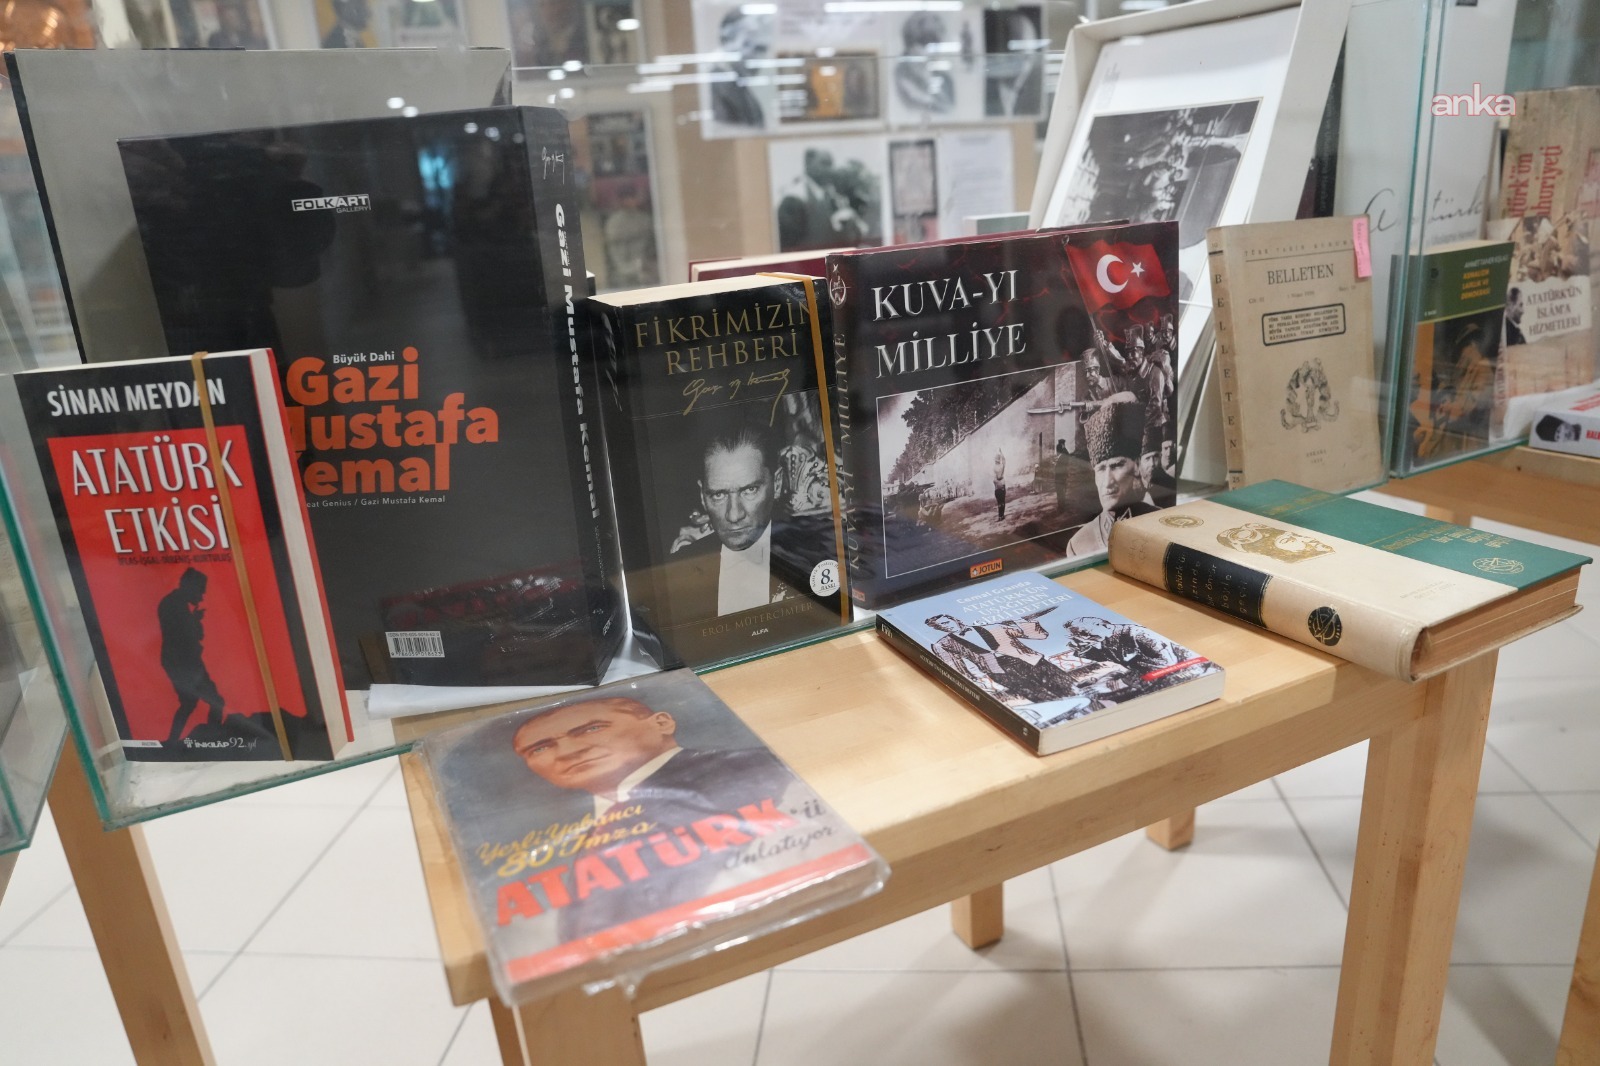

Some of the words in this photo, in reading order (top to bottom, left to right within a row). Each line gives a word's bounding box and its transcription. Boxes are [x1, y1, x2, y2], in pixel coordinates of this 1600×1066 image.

[292, 194, 370, 212] FOLKART
[871, 269, 1019, 321] KUVA-YI
[1267, 263, 1335, 285] BELLETEN
[635, 298, 811, 348] FİKRİMİZİN
[333, 353, 367, 366] Büyük
[369, 351, 395, 362] Dahi
[555, 203, 572, 278] Gazi
[564, 284, 584, 415] Mustafa
[580, 422, 601, 519] Kemal
[665, 328, 799, 376] REHBERİ
[874, 321, 1027, 379] MİLLİYE
[47, 384, 120, 417] SİNAN
[124, 378, 226, 412] MEYDAN
[286, 346, 419, 406] Gazi
[72, 435, 244, 496] ATATÜRK
[299, 442, 450, 496] emal
[322, 499, 352, 507] Genius
[361, 498, 380, 506] Gazi
[382, 496, 416, 505] Mustafa
[419, 495, 446, 503] Kemal
[104, 494, 230, 554] ETKİSİ
[820, 568, 834, 585] 8.
[979, 561, 1001, 575] JOTUN
[702, 624, 731, 638] EROL
[751, 627, 769, 637] ALFA
